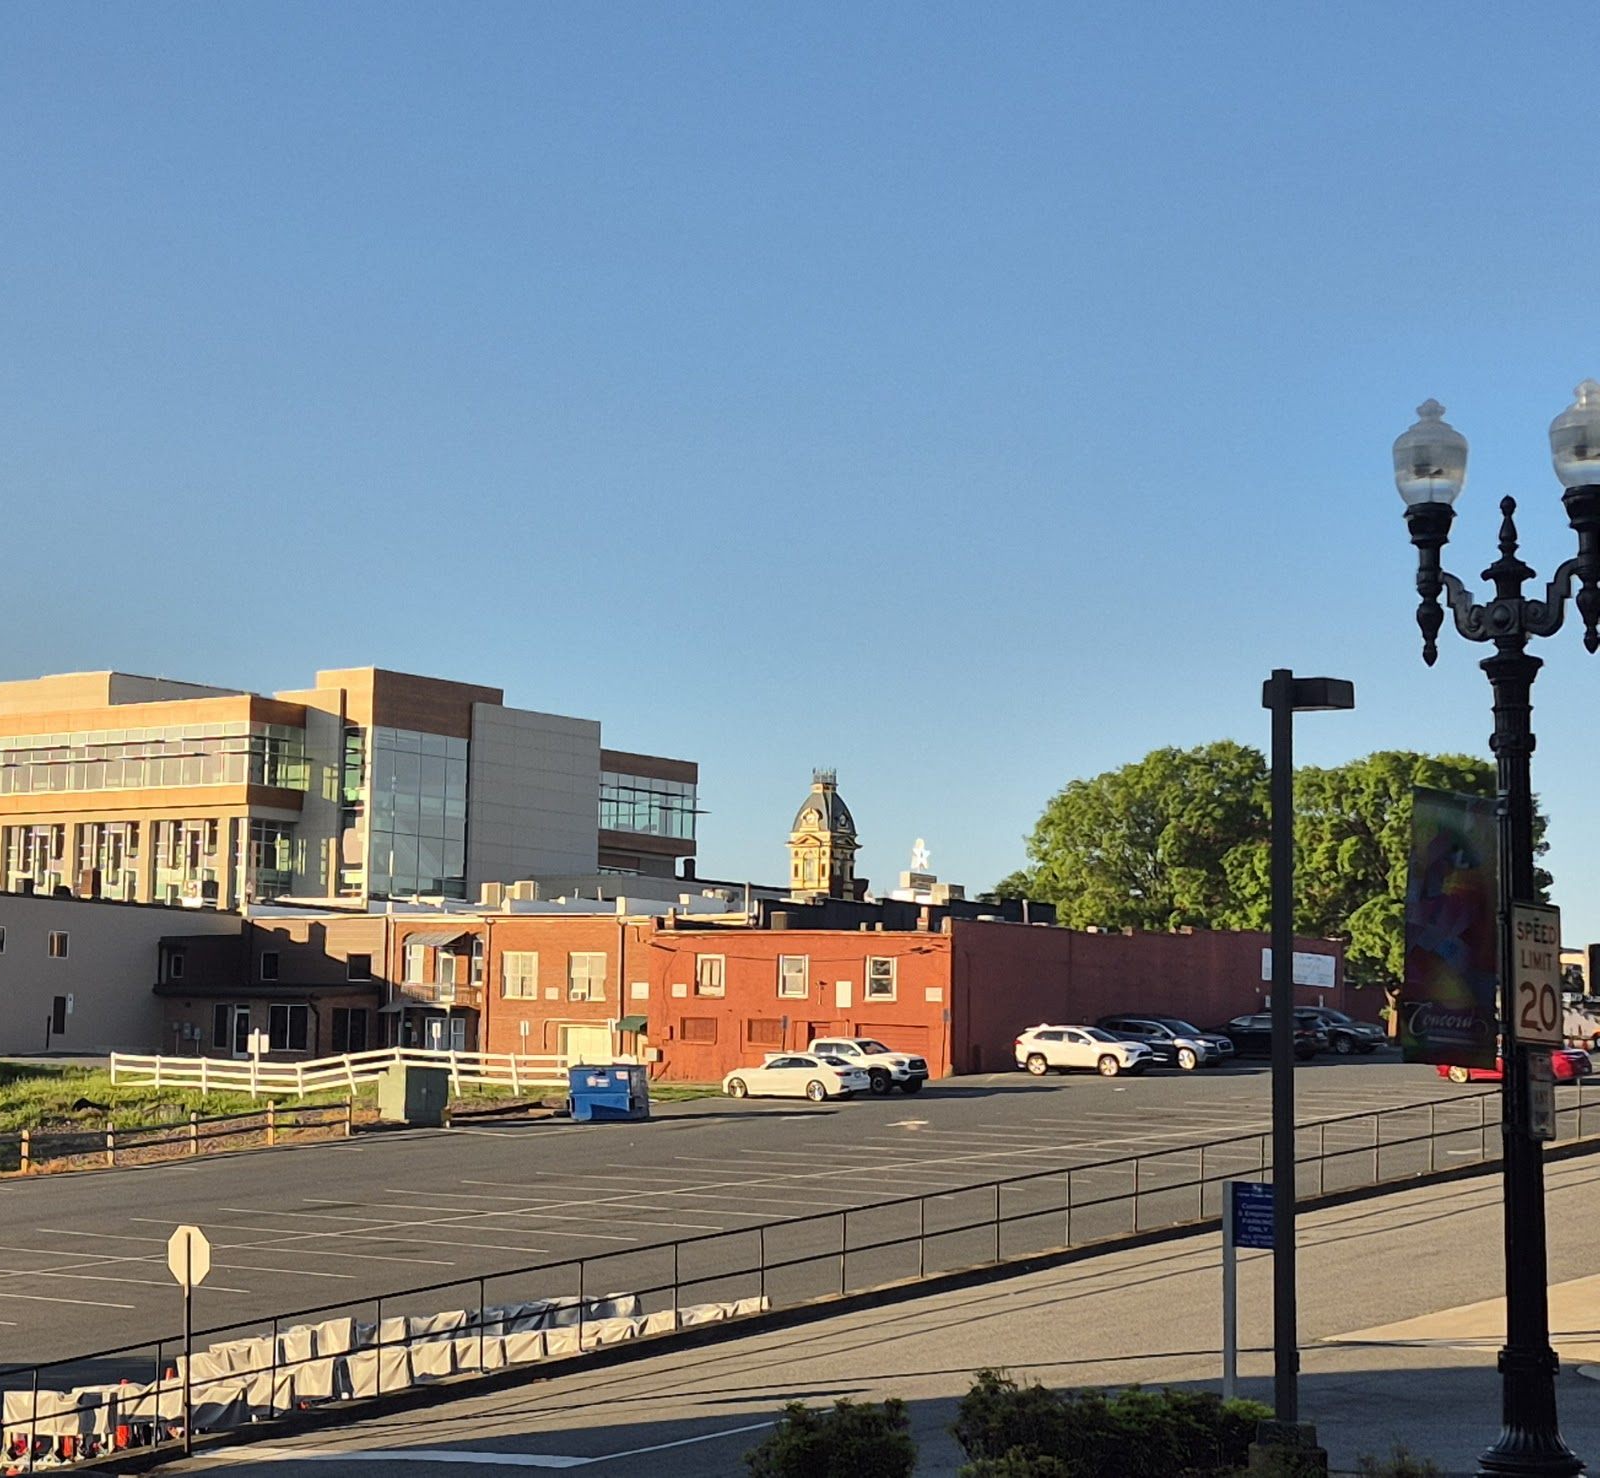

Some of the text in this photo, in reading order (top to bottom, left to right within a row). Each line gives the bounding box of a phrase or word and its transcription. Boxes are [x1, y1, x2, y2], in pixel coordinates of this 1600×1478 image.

[1516, 920, 1558, 945] SPEED
[1521, 948, 1554, 972] LIMIT
[1403, 1001, 1487, 1036] Concord
[1519, 983, 1558, 1032] 20
